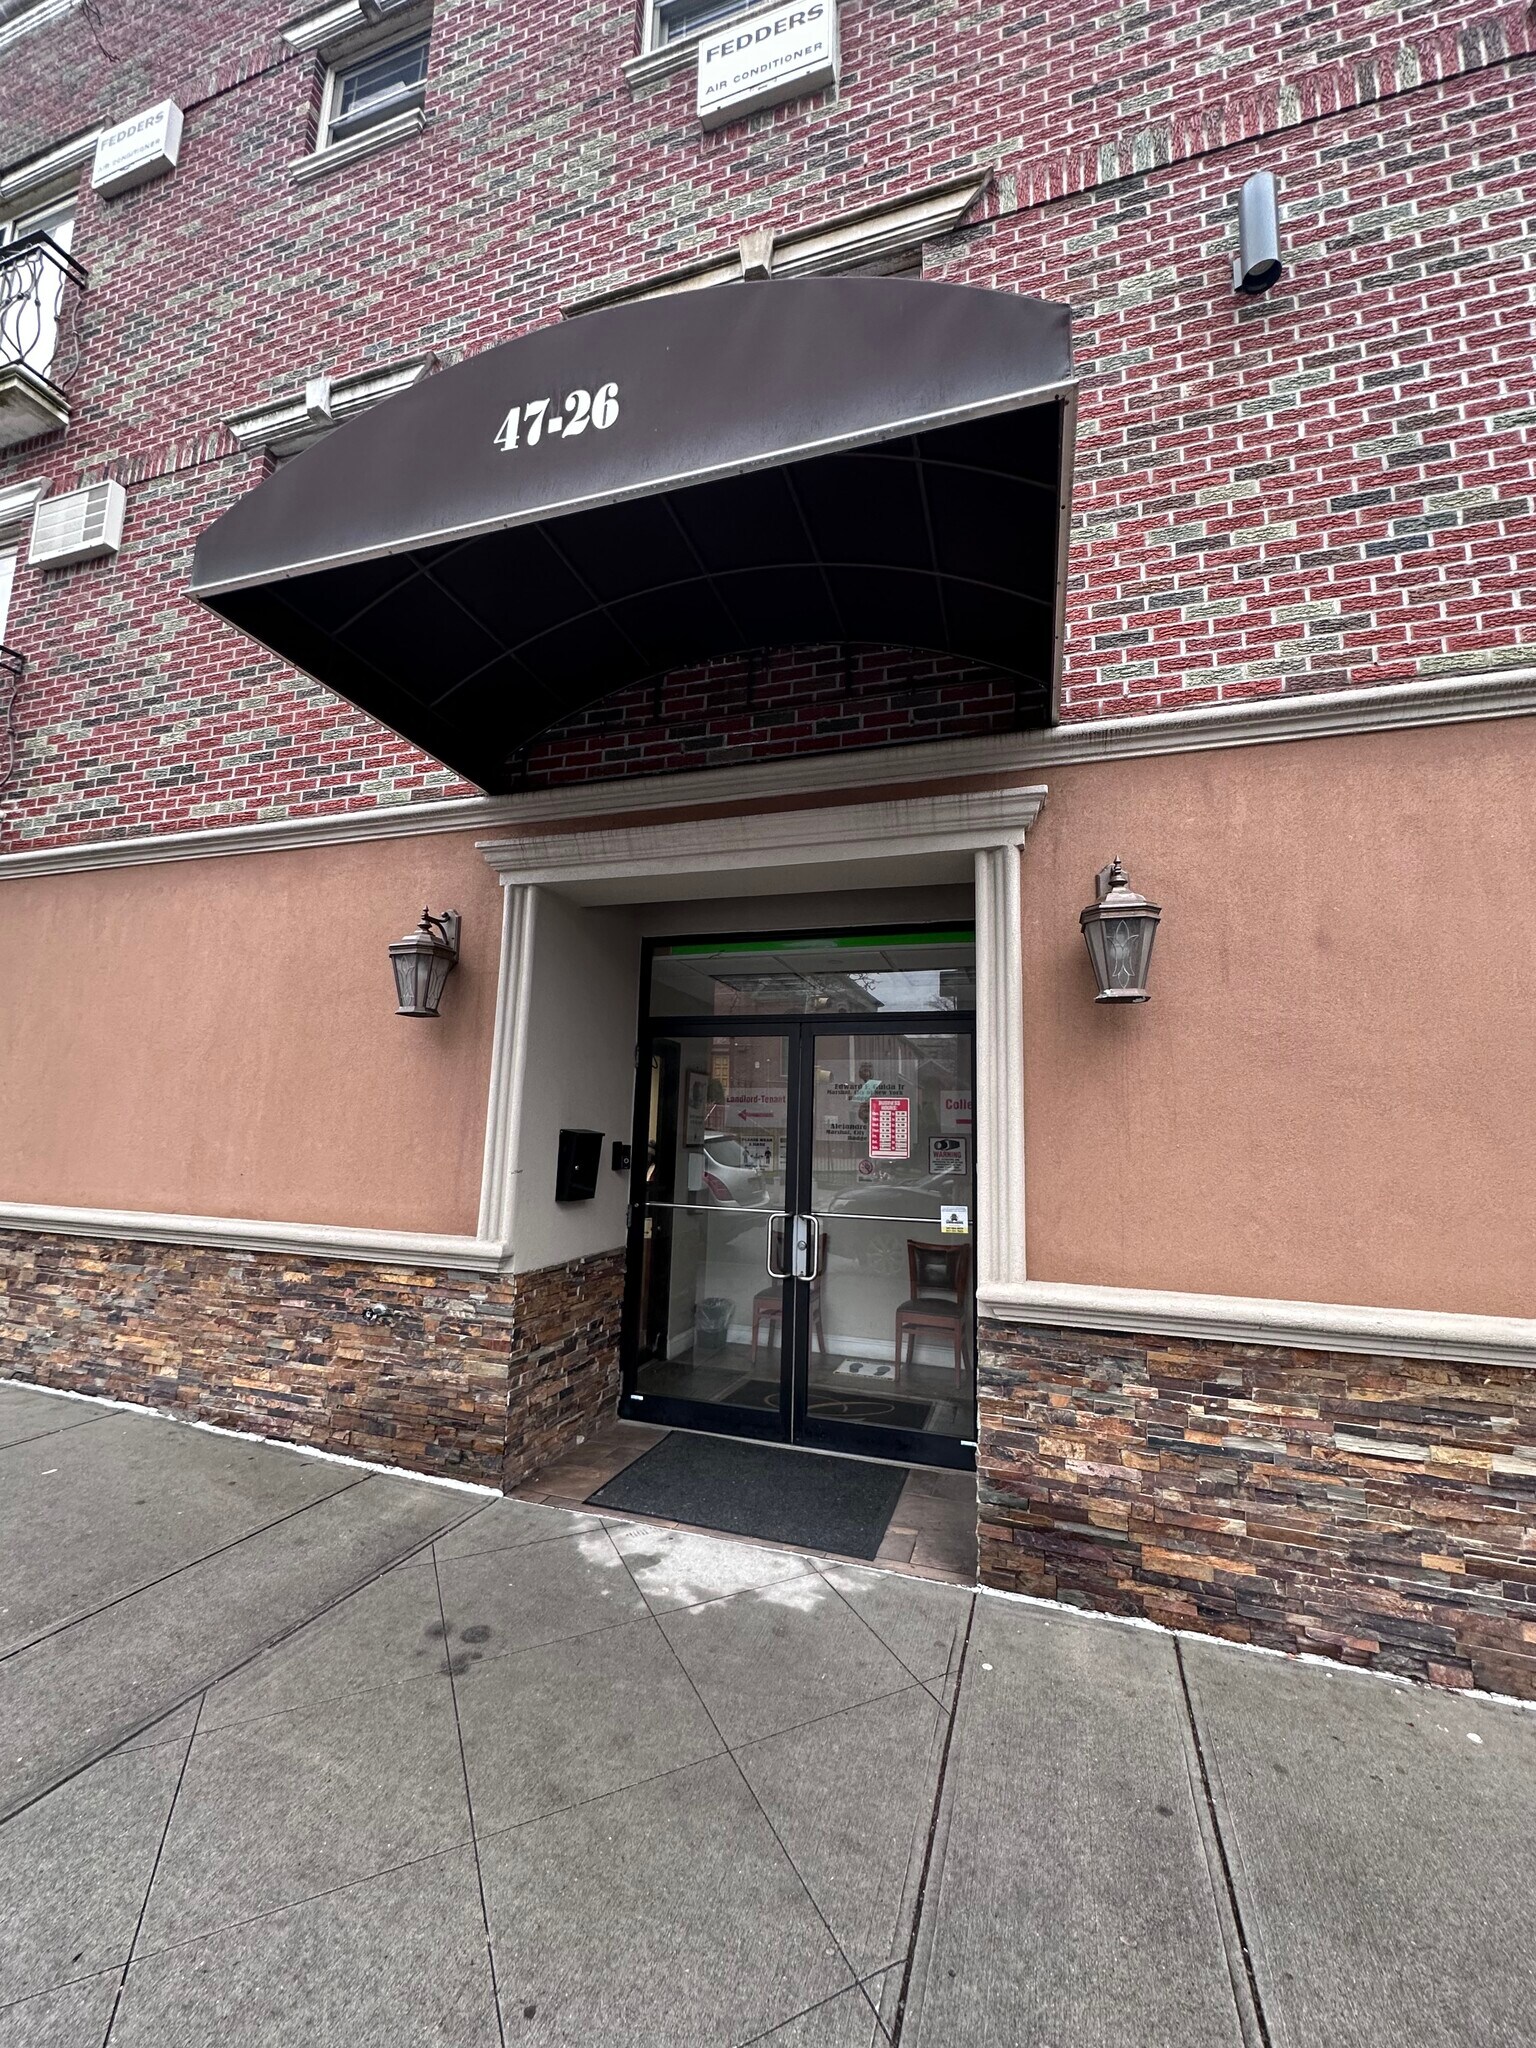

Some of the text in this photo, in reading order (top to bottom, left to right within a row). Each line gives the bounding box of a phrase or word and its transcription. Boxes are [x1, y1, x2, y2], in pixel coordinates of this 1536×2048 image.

[706, 4, 824, 63] FEDDERS
[706, 42, 823, 95] AIR CONDITIONER
[101, 110, 164, 152] FEDDERS
[493, 382, 620, 452] 47-26
[726, 1095, 786, 1103] Landlord-Tenant
[933, 1150, 962, 1158] WARNING
